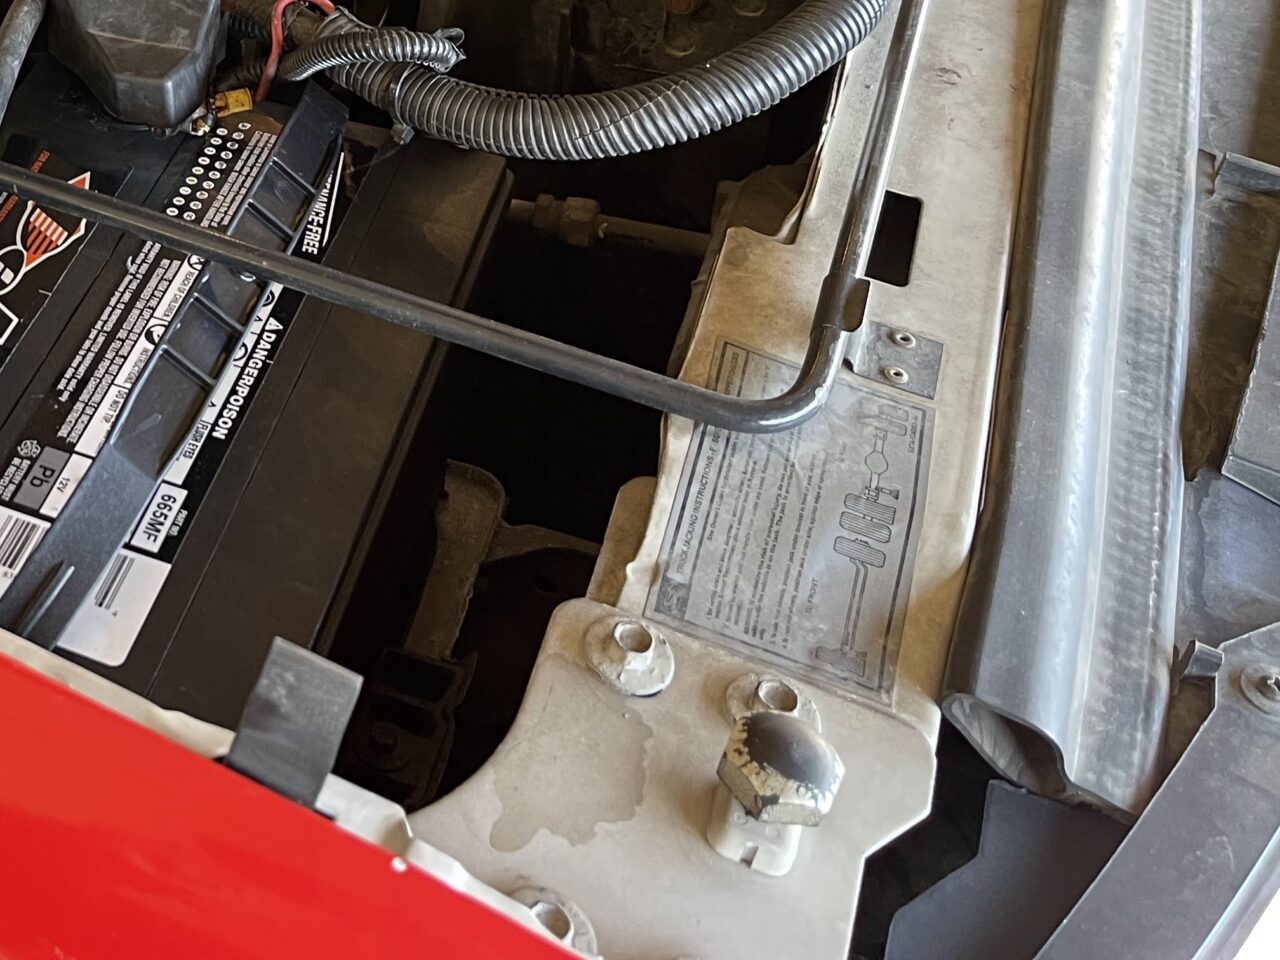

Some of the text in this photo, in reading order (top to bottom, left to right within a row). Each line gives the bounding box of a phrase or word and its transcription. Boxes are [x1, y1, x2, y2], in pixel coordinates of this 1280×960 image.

[143, 242, 161, 263] ARRANTY
[180, 270, 195, 287] REACH
[176, 286, 186, 294] OF
[114, 389, 125, 399] DO
[210, 329, 276, 442] DANGER/POISON
[107, 399, 120, 412] NOT
[10, 456, 21, 467] BE
[0, 458, 31, 501] BATTERY MUST
[28, 462, 56, 491] Pb
[55, 475, 70, 493] 12V
[682, 513, 698, 549] JACKING
[691, 455, 714, 514] INSTRUCTIONS
[141, 490, 177, 545] 665MF
[174, 507, 187, 526] PART
[807, 576, 818, 604] FRONT
